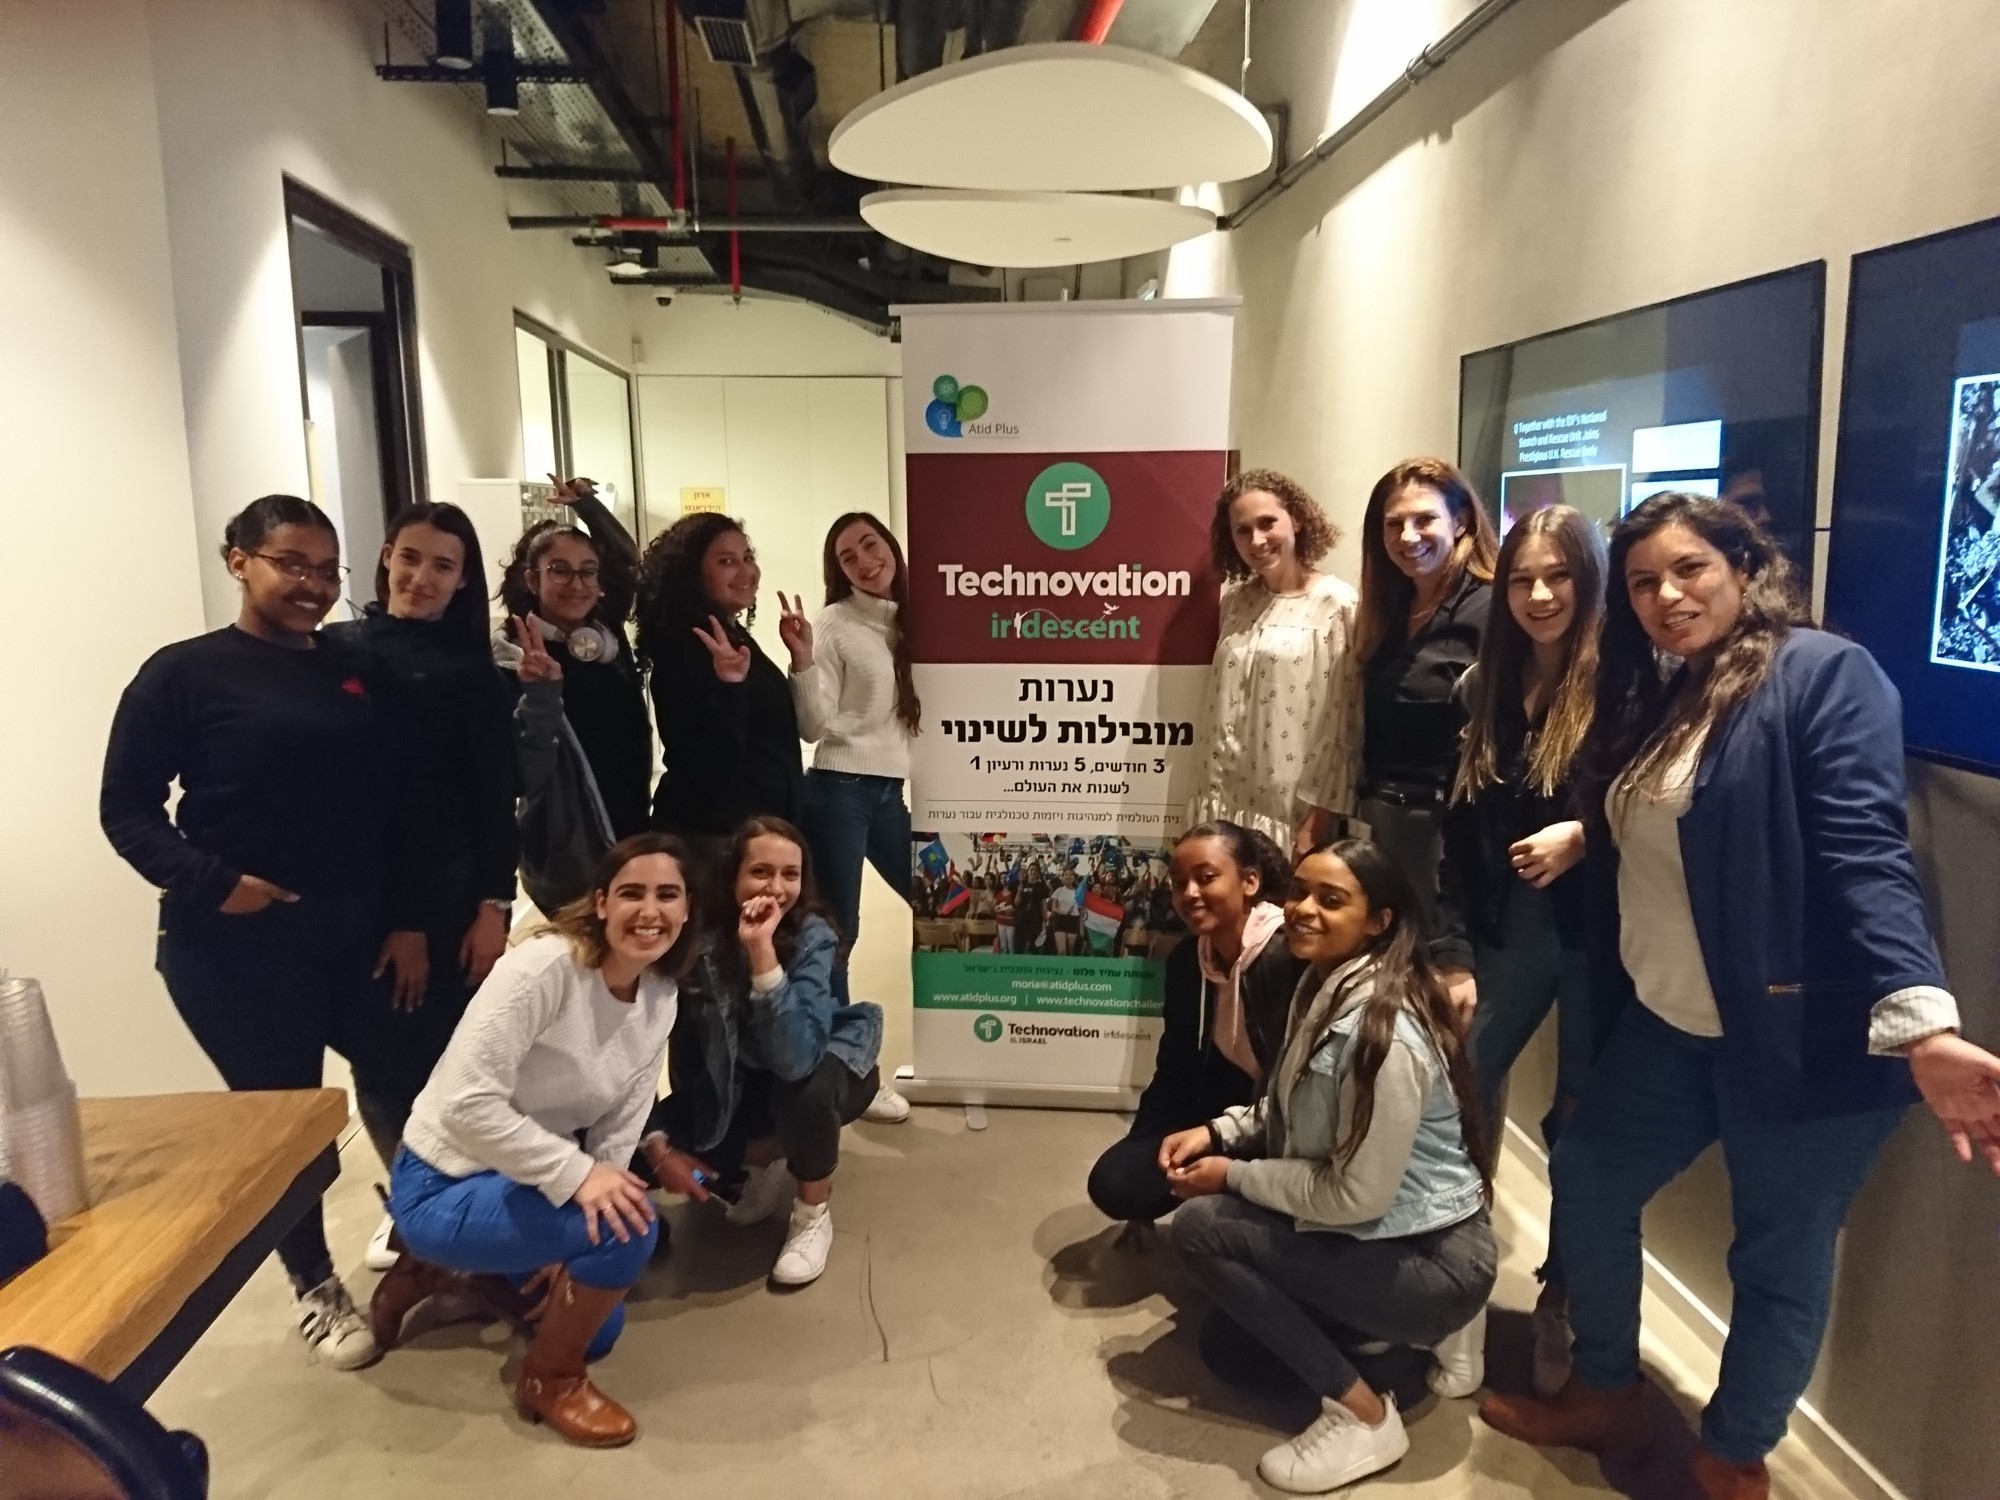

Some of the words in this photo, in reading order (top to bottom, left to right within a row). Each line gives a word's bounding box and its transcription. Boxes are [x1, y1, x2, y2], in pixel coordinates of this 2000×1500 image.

[968, 423, 992, 435] Atid
[995, 423, 1020, 435] Plus
[1519, 420, 1542, 434] Together
[694, 492, 711, 500] ארון
[938, 563, 1191, 597] Technovation
[1018, 677, 1114, 702] נערות
[941, 712, 1047, 743] לשינוי
[1057, 713, 1194, 746] מובילות
[969, 755, 981, 771] 1
[986, 759, 1024, 774] ורעיון
[1028, 760, 1068, 772] נערות
[1073, 757, 1086, 772] 5
[1089, 760, 1147, 775] חודשים,
[1152, 758, 1166, 774] 3
[1061, 782, 1082, 794] את
[1086, 781, 1130, 794] לשנות
[927, 810, 957, 819] נערות
[959, 810, 982, 819] עבור
[984, 809, 1030, 820] טכנולגית
[1032, 811, 1064, 820] ויזמות
[1066, 810, 1113, 822] למנהיגות
[1115, 811, 1160, 823] העולמית
[1011, 978, 1112, 993] moria@atidplus.com
[932, 992, 1017, 1006] www.atidplus.org
[1008, 1023, 1099, 1039] Technovation
